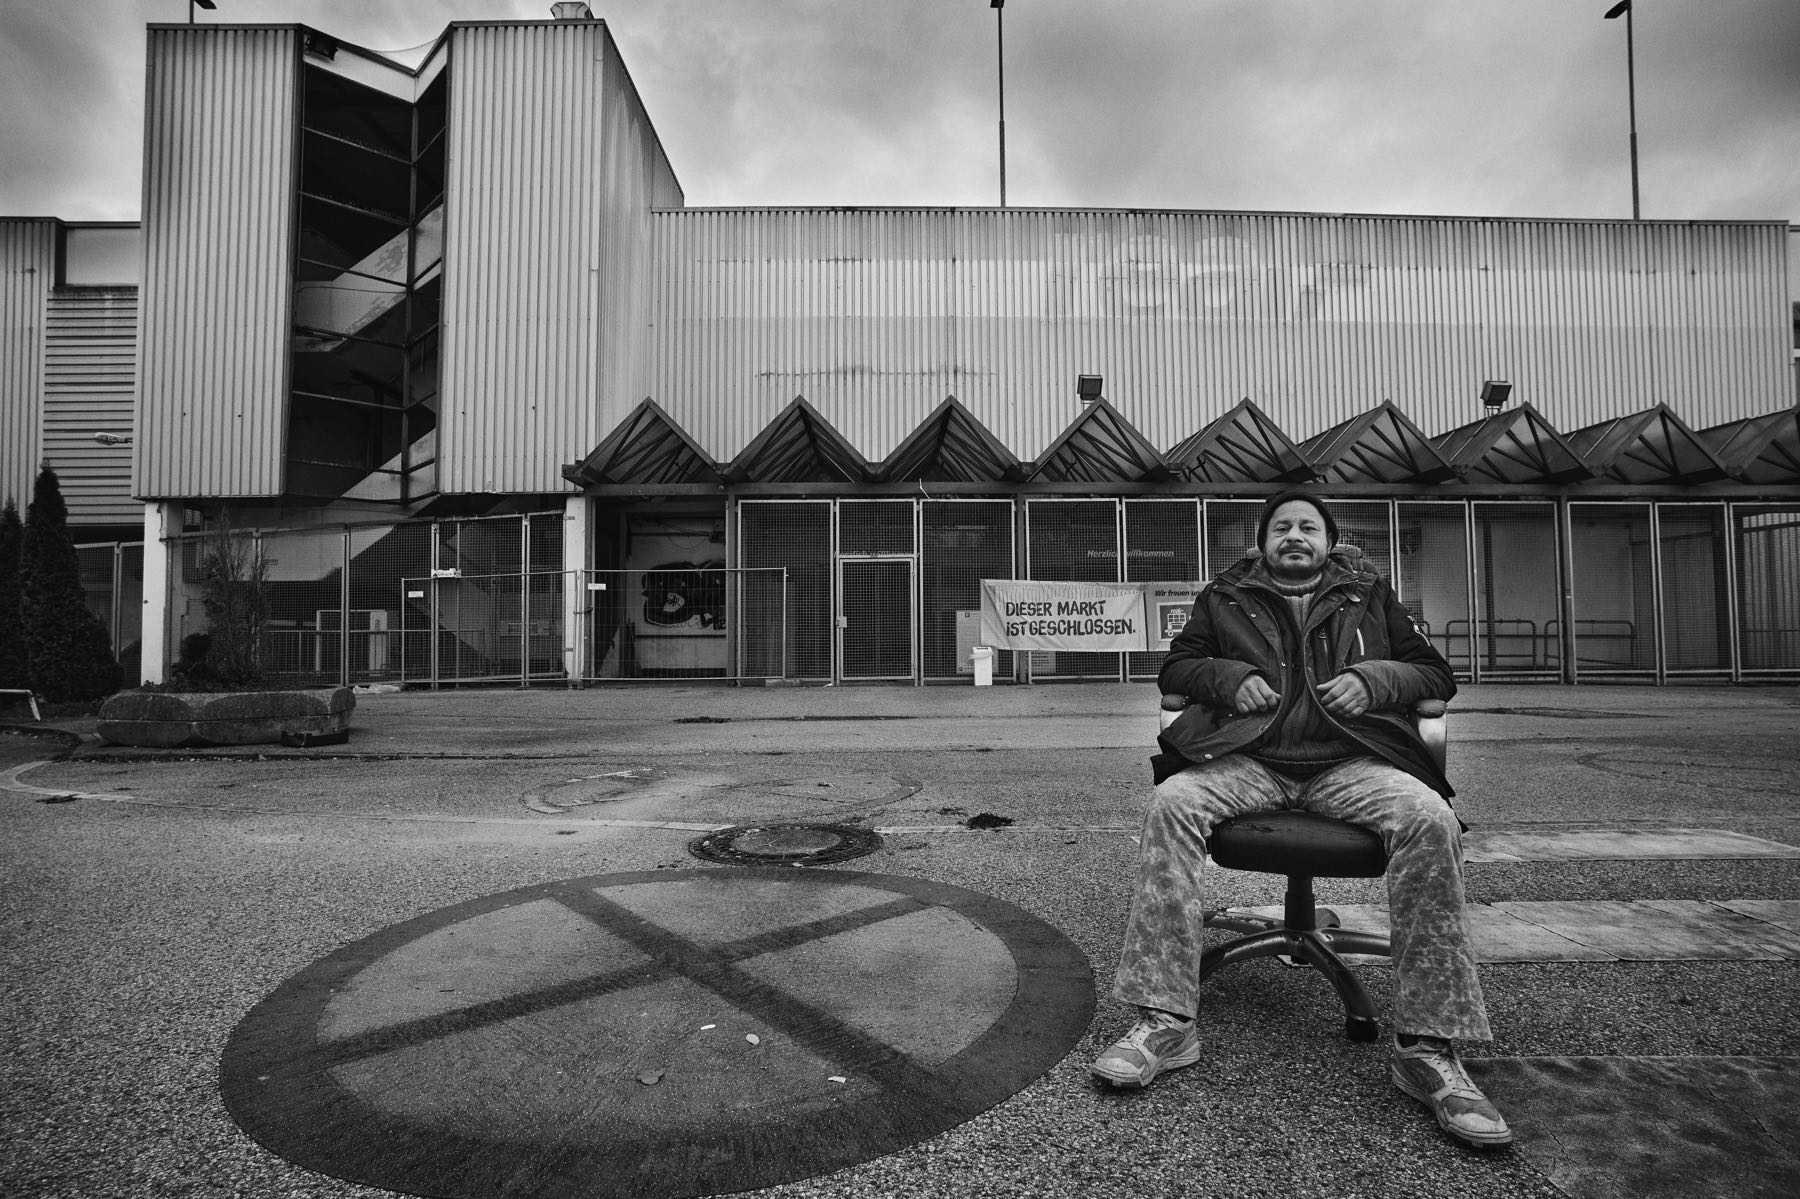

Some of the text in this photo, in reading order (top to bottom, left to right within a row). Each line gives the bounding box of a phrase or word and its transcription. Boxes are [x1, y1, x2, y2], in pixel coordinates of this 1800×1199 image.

[1087, 549, 1119, 558] Herzlic
[1154, 589, 1167, 597] Wir
[1167, 589, 1189, 597] freuen
[1005, 600, 1106, 617] DIESER MARKT
[1029, 618, 1136, 636] GESCHLOSSEN.
